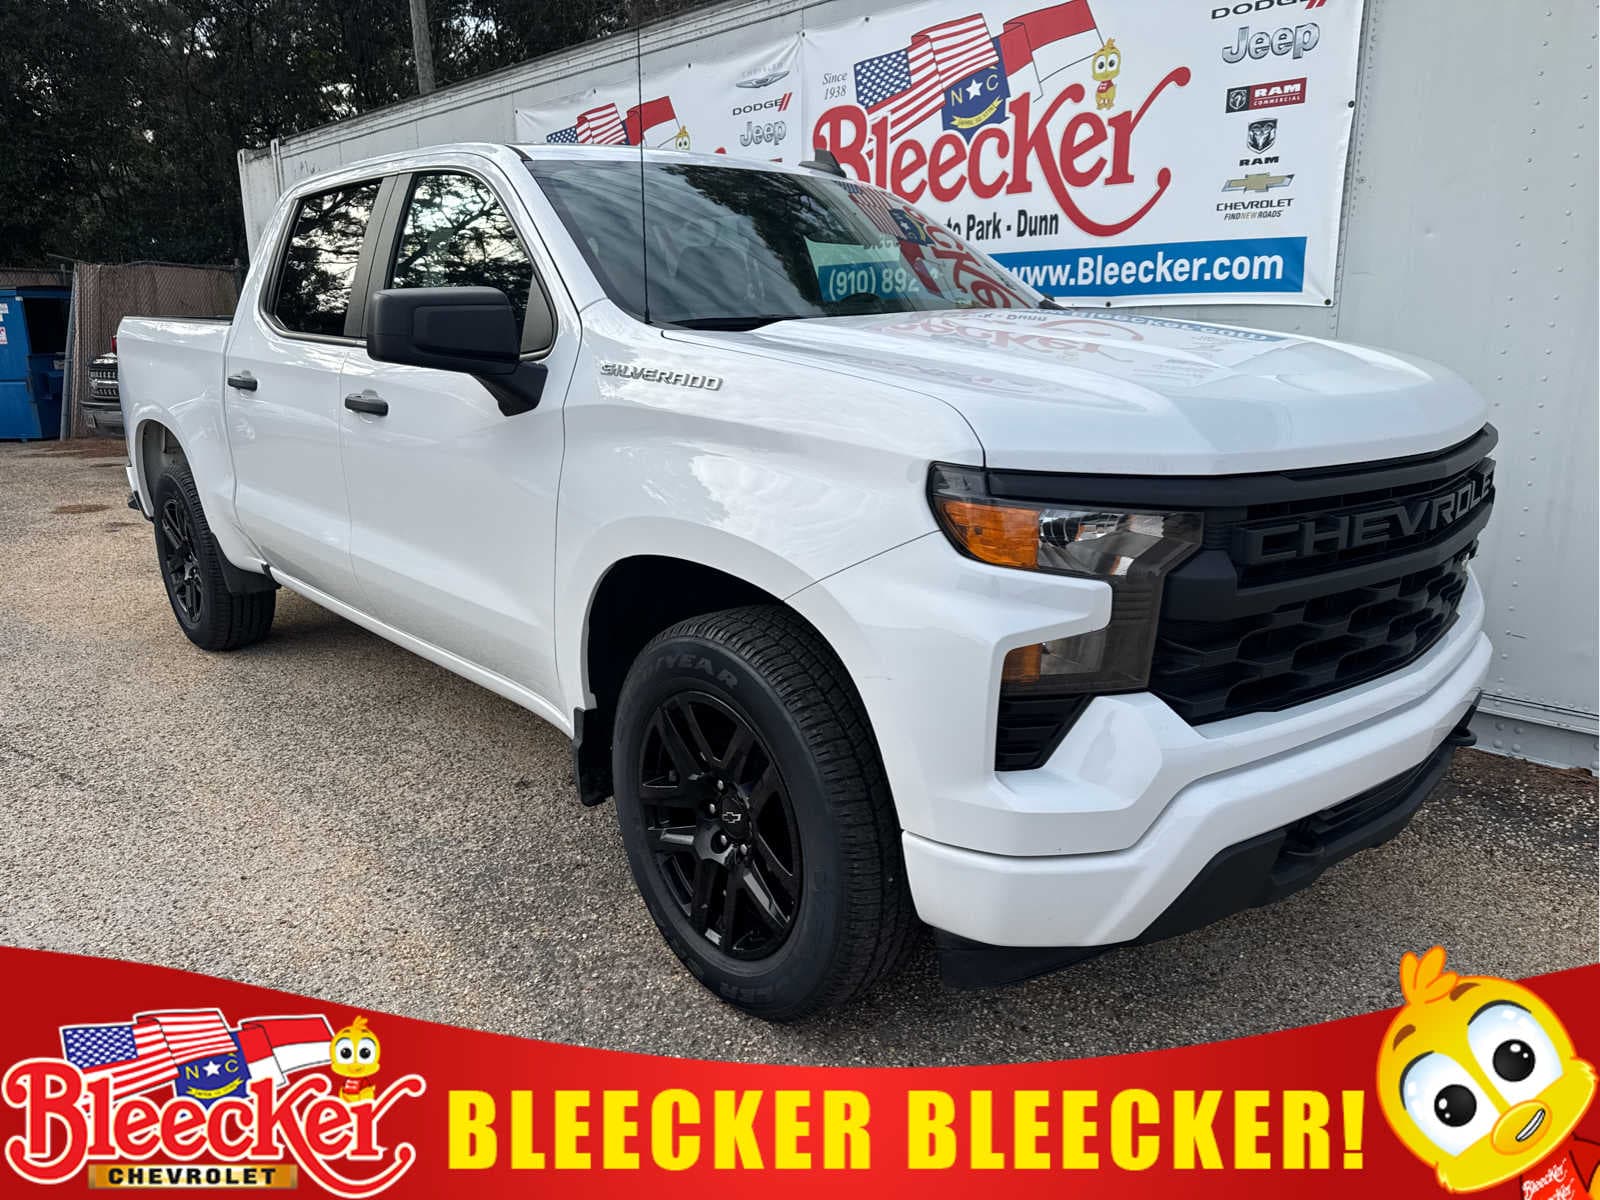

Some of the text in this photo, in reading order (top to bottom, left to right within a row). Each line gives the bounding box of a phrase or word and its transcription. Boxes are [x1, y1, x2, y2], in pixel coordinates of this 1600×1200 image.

[1222, 22, 1320, 63] Jeep
[823, 73, 847, 85] Since
[951, 74, 999, 106] N C
[1254, 83, 1301, 98] RAM
[825, 86, 847, 100] 1938
[1253, 96, 1301, 106] COMMERCIAL
[732, 97, 782, 116] DODGE
[740, 120, 786, 147] Jeep
[813, 66, 1192, 237] Bleecker
[1239, 156, 1279, 167] RAM
[1216, 198, 1295, 212] CHEVROLET
[966, 211, 1002, 241] Park
[1016, 209, 1059, 237] Dunn
[600, 362, 724, 392] SILVERADO
[1240, 473, 1492, 566] CHEVROLE
